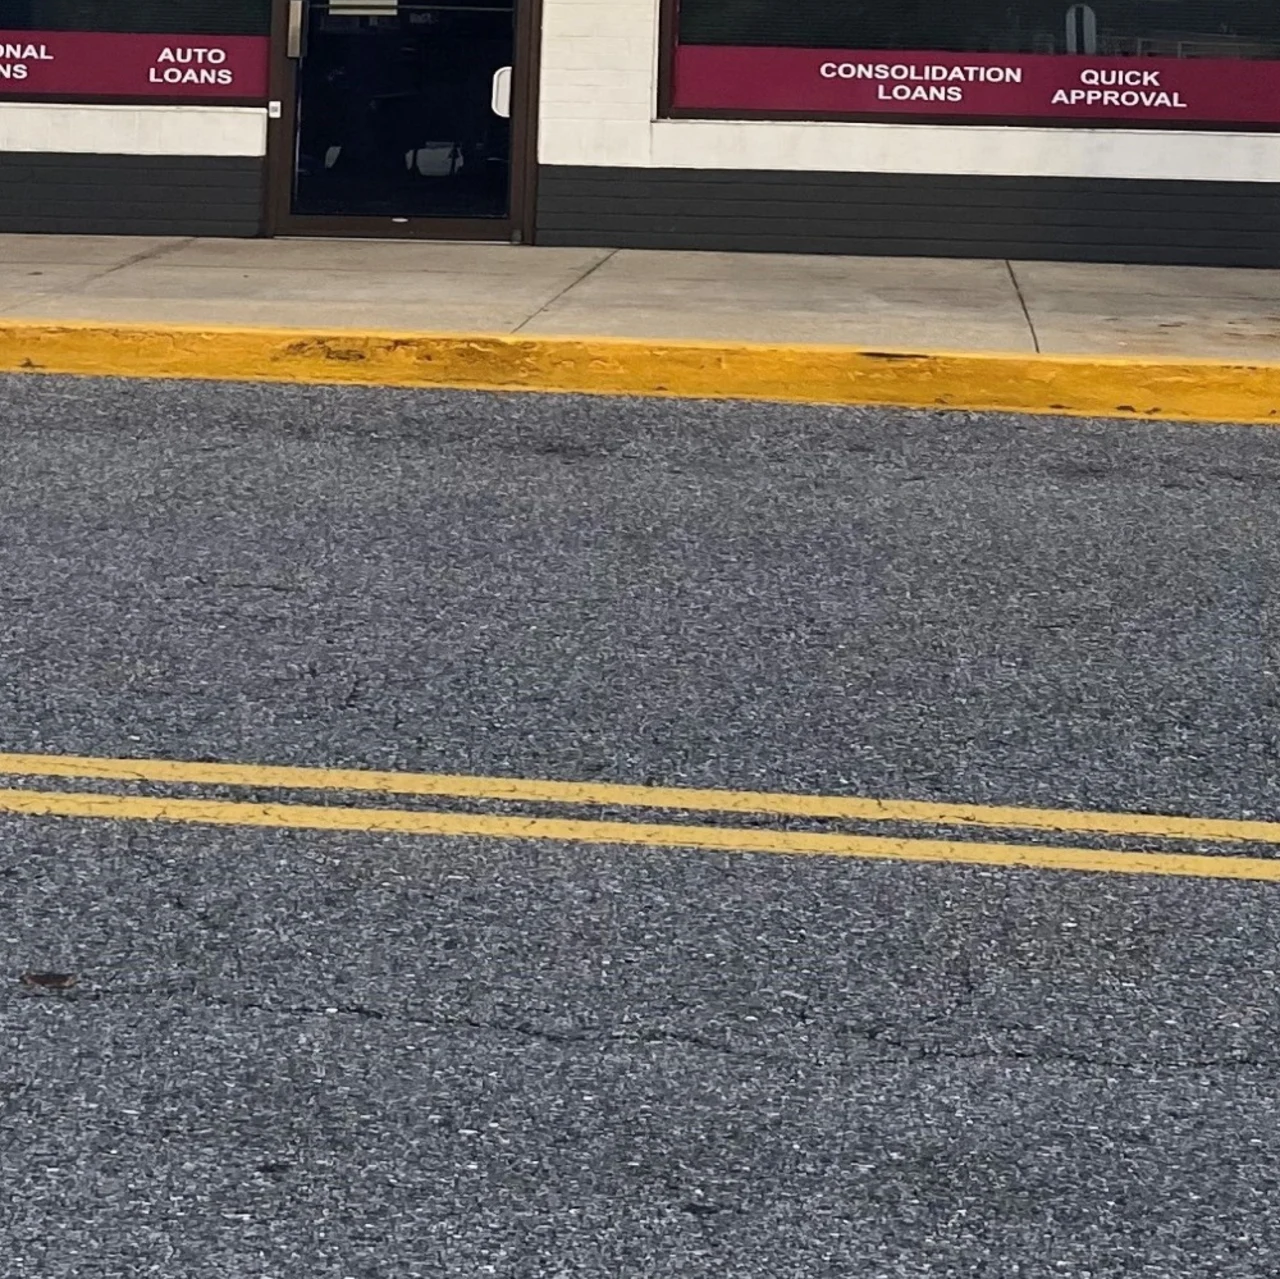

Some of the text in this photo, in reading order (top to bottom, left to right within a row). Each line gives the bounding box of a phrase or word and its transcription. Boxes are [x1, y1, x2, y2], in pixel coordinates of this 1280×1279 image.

[157, 47, 226, 64] AUTO
[149, 67, 233, 85] LOANS
[820, 62, 1022, 83] CONSOLIDATION
[1080, 69, 1160, 87] QUICK
[877, 84, 963, 102] LOANS
[1051, 89, 1187, 108] APPROVAL
